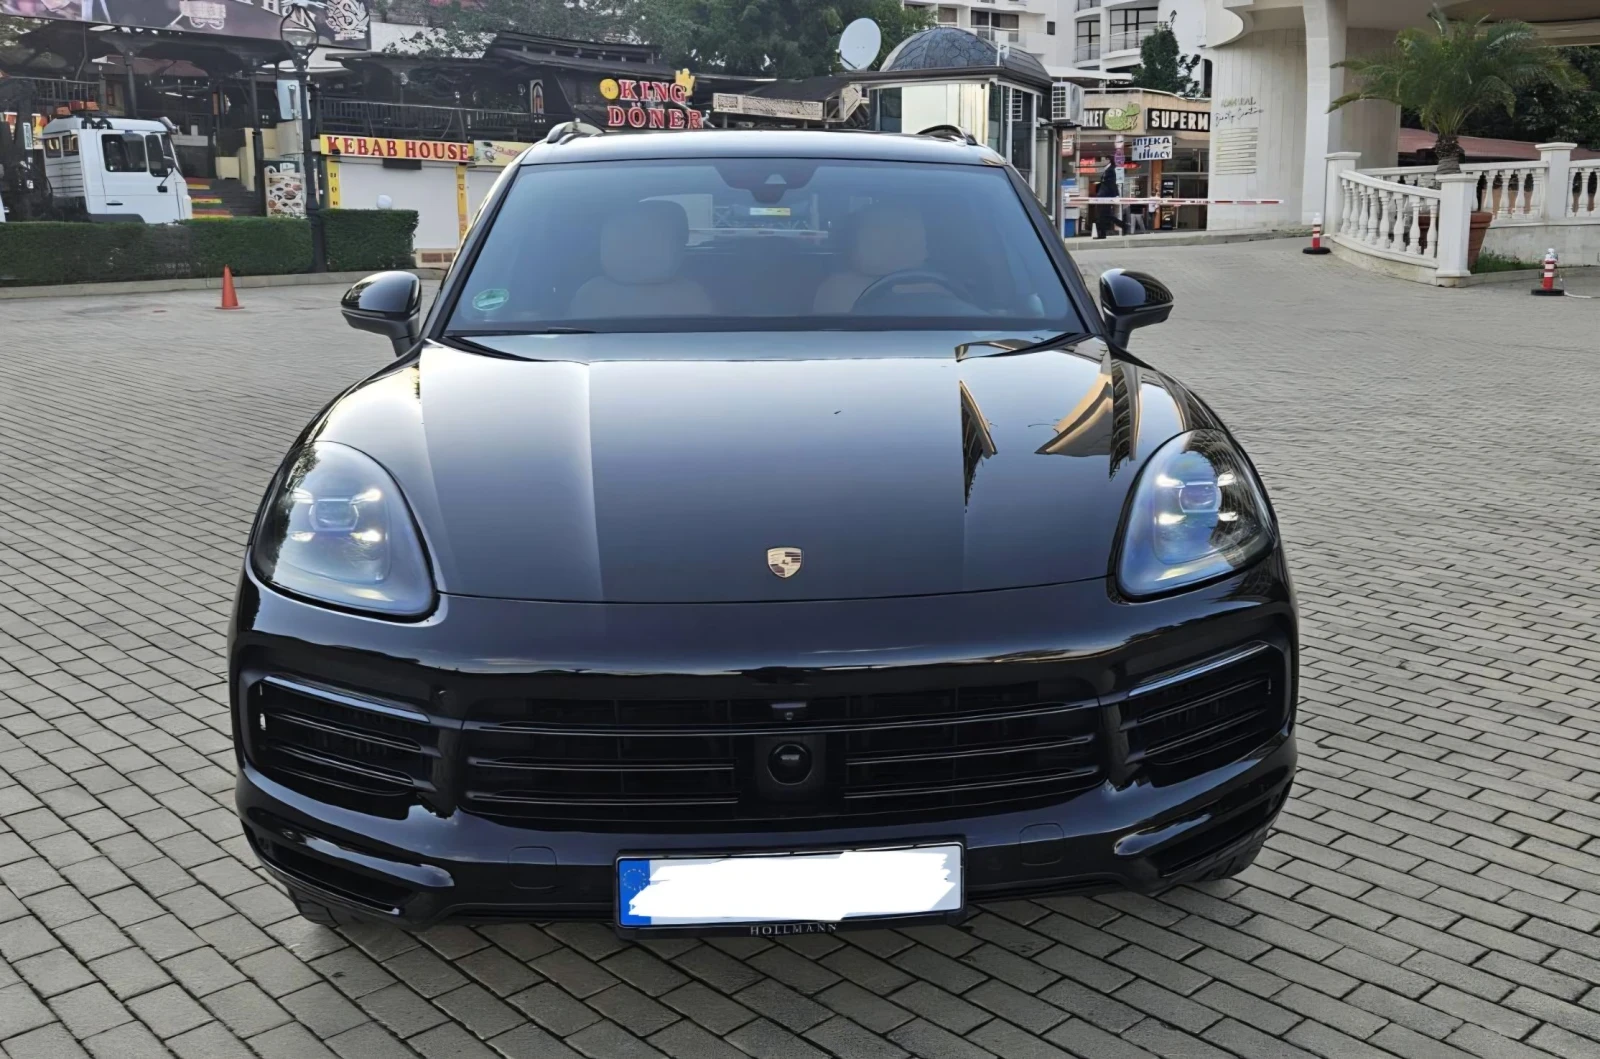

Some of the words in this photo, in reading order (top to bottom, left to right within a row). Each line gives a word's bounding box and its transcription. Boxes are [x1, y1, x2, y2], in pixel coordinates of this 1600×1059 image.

[619, 79, 687, 104] KING
[607, 102, 703, 128] DÖNER
[1151, 110, 1209, 130] SUPERM
[326, 136, 398, 157] KEBAB
[405, 140, 469, 160] HOUSE
[750, 923, 837, 936] HOLLMANN
